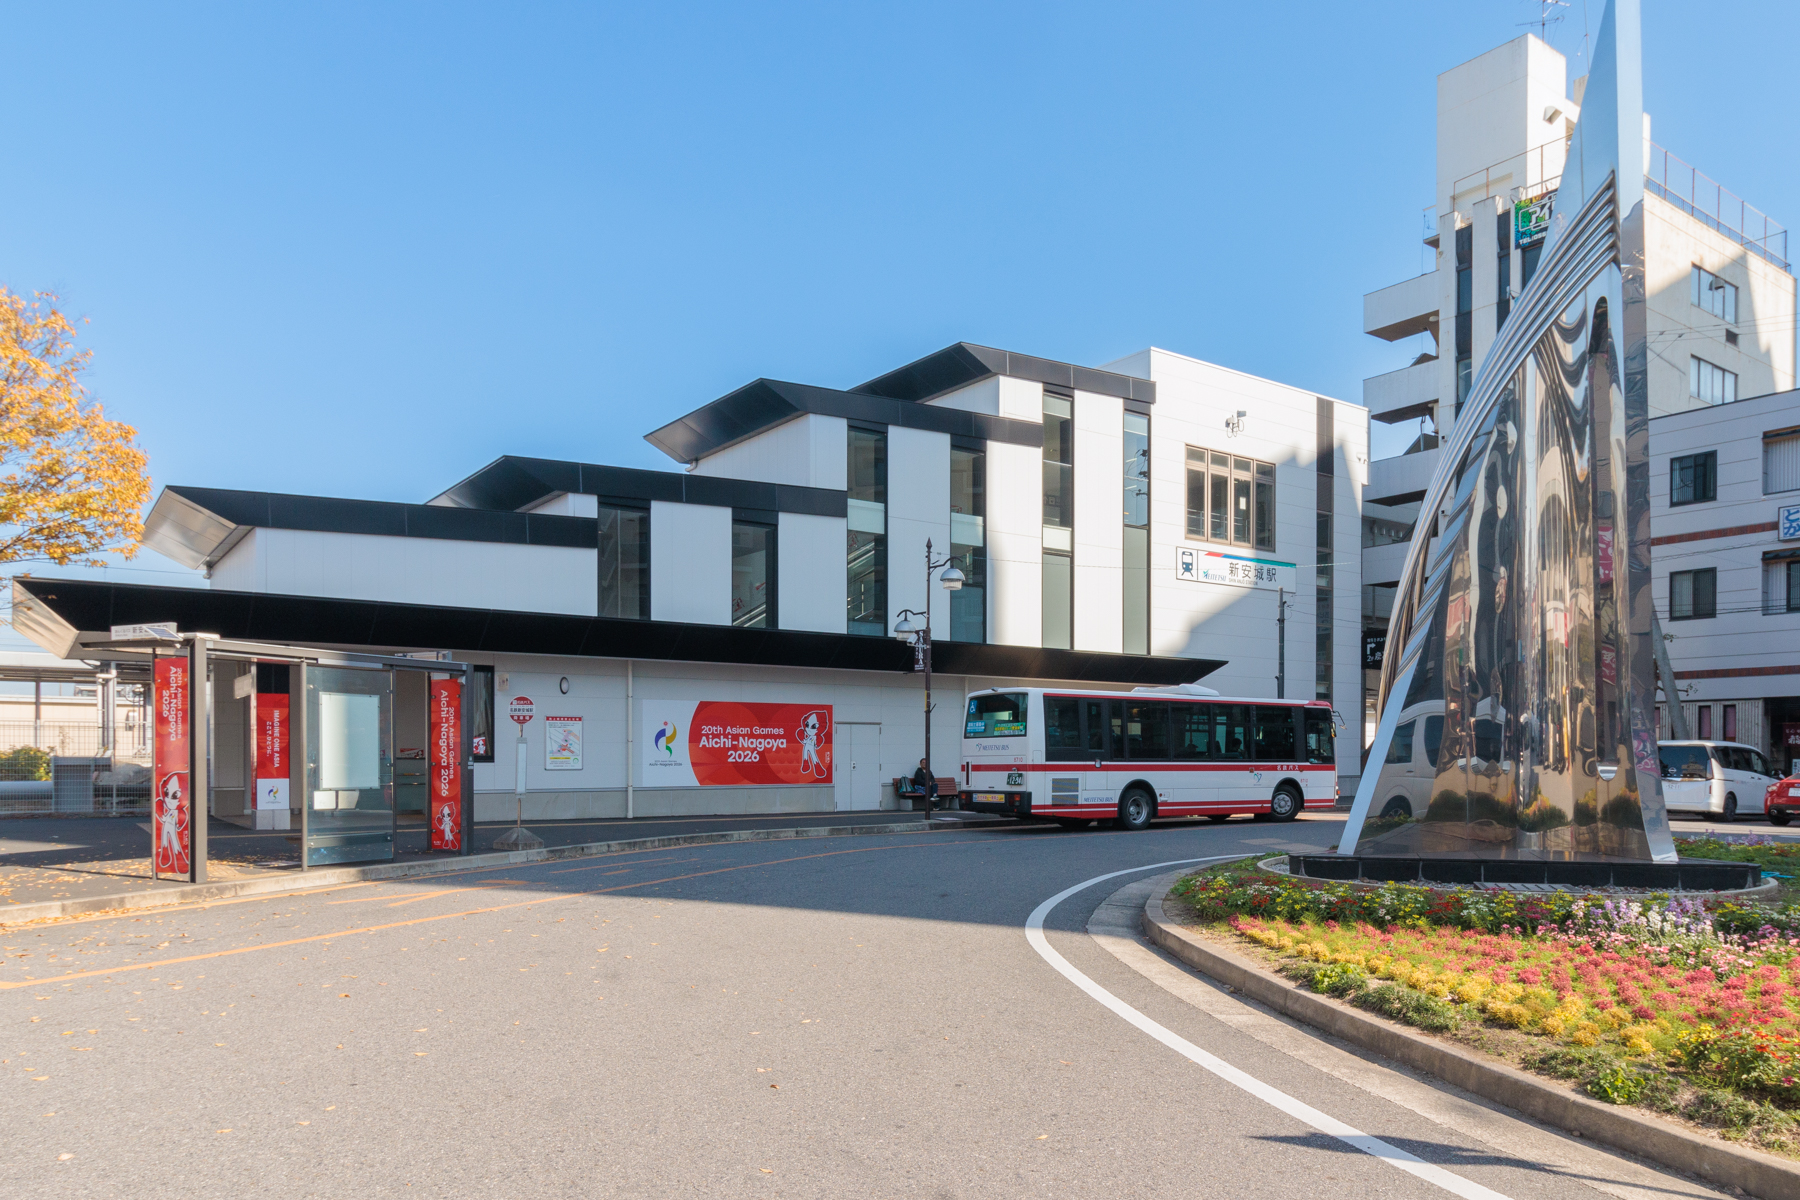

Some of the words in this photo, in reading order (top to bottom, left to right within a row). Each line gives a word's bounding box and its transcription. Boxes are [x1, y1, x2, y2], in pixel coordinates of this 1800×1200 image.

[1229, 562, 1277, 582] 新安城駅
[168, 666, 178, 741] Aichi-Nagoya
[439, 690, 449, 766] Aichi-Nagoya
[701, 725, 723, 734] 20th
[725, 726, 751, 735] Asian
[752, 726, 784, 735] Games
[699, 735, 786, 751] Aichi-Nagoya
[727, 750, 760, 762] 2026
[441, 769, 449, 797] 2026
